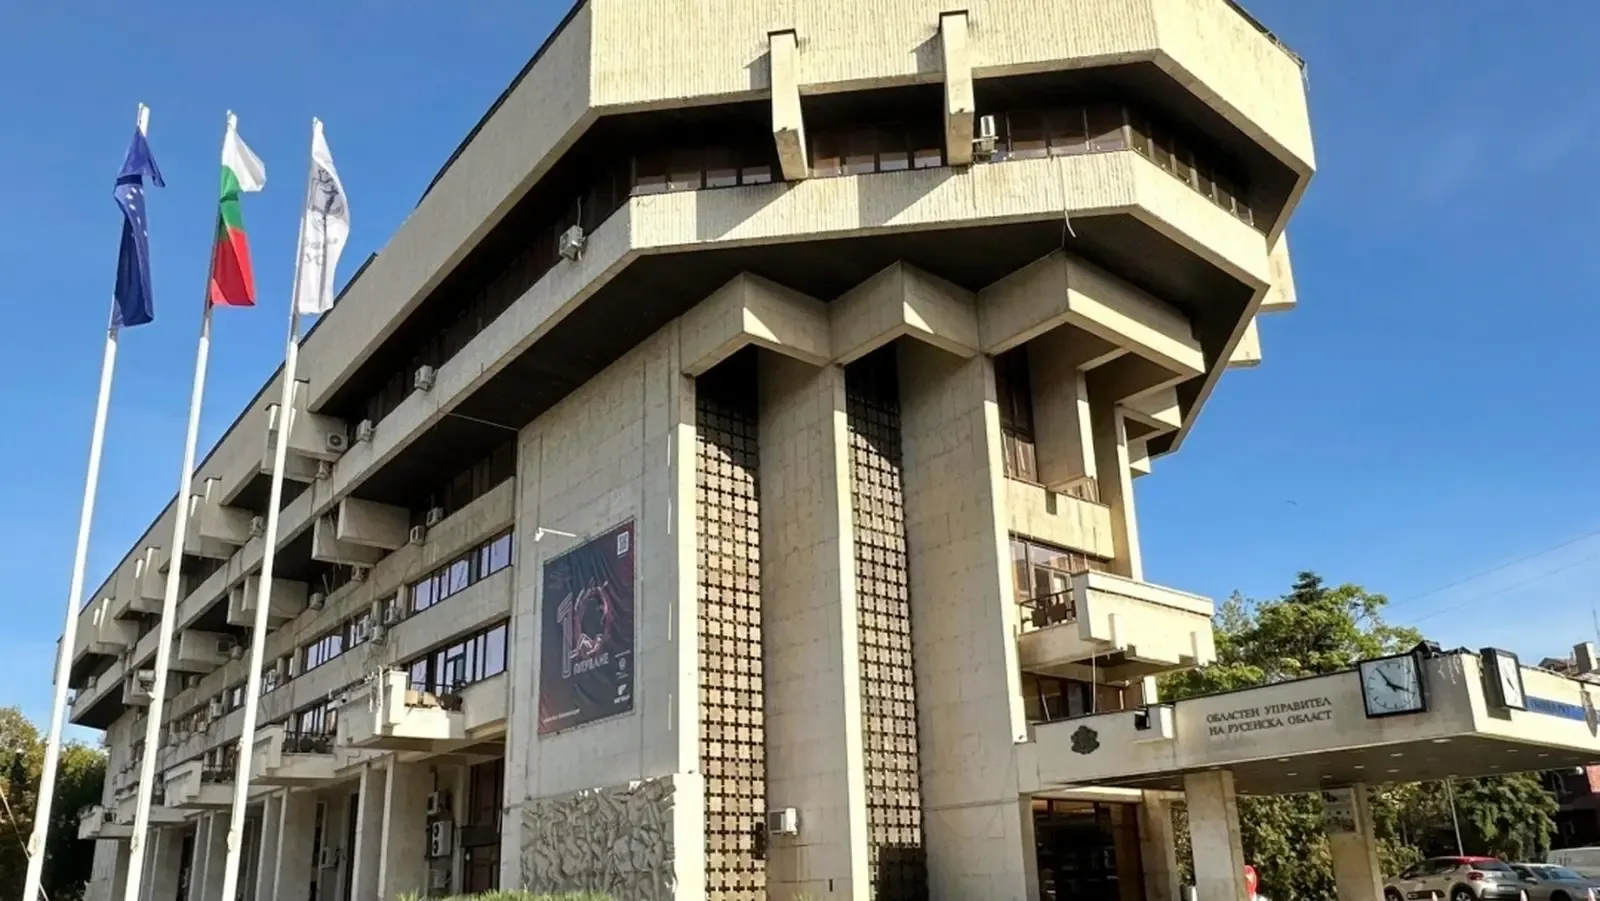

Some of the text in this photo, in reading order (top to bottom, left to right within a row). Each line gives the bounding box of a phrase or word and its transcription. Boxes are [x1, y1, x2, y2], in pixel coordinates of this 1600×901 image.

[1206, 696, 1332, 724] ОБЛАСТЕН УПРАВИТЕЛ
[1209, 710, 1333, 736] НА РУСЕНСКА ОБЛАСТ
